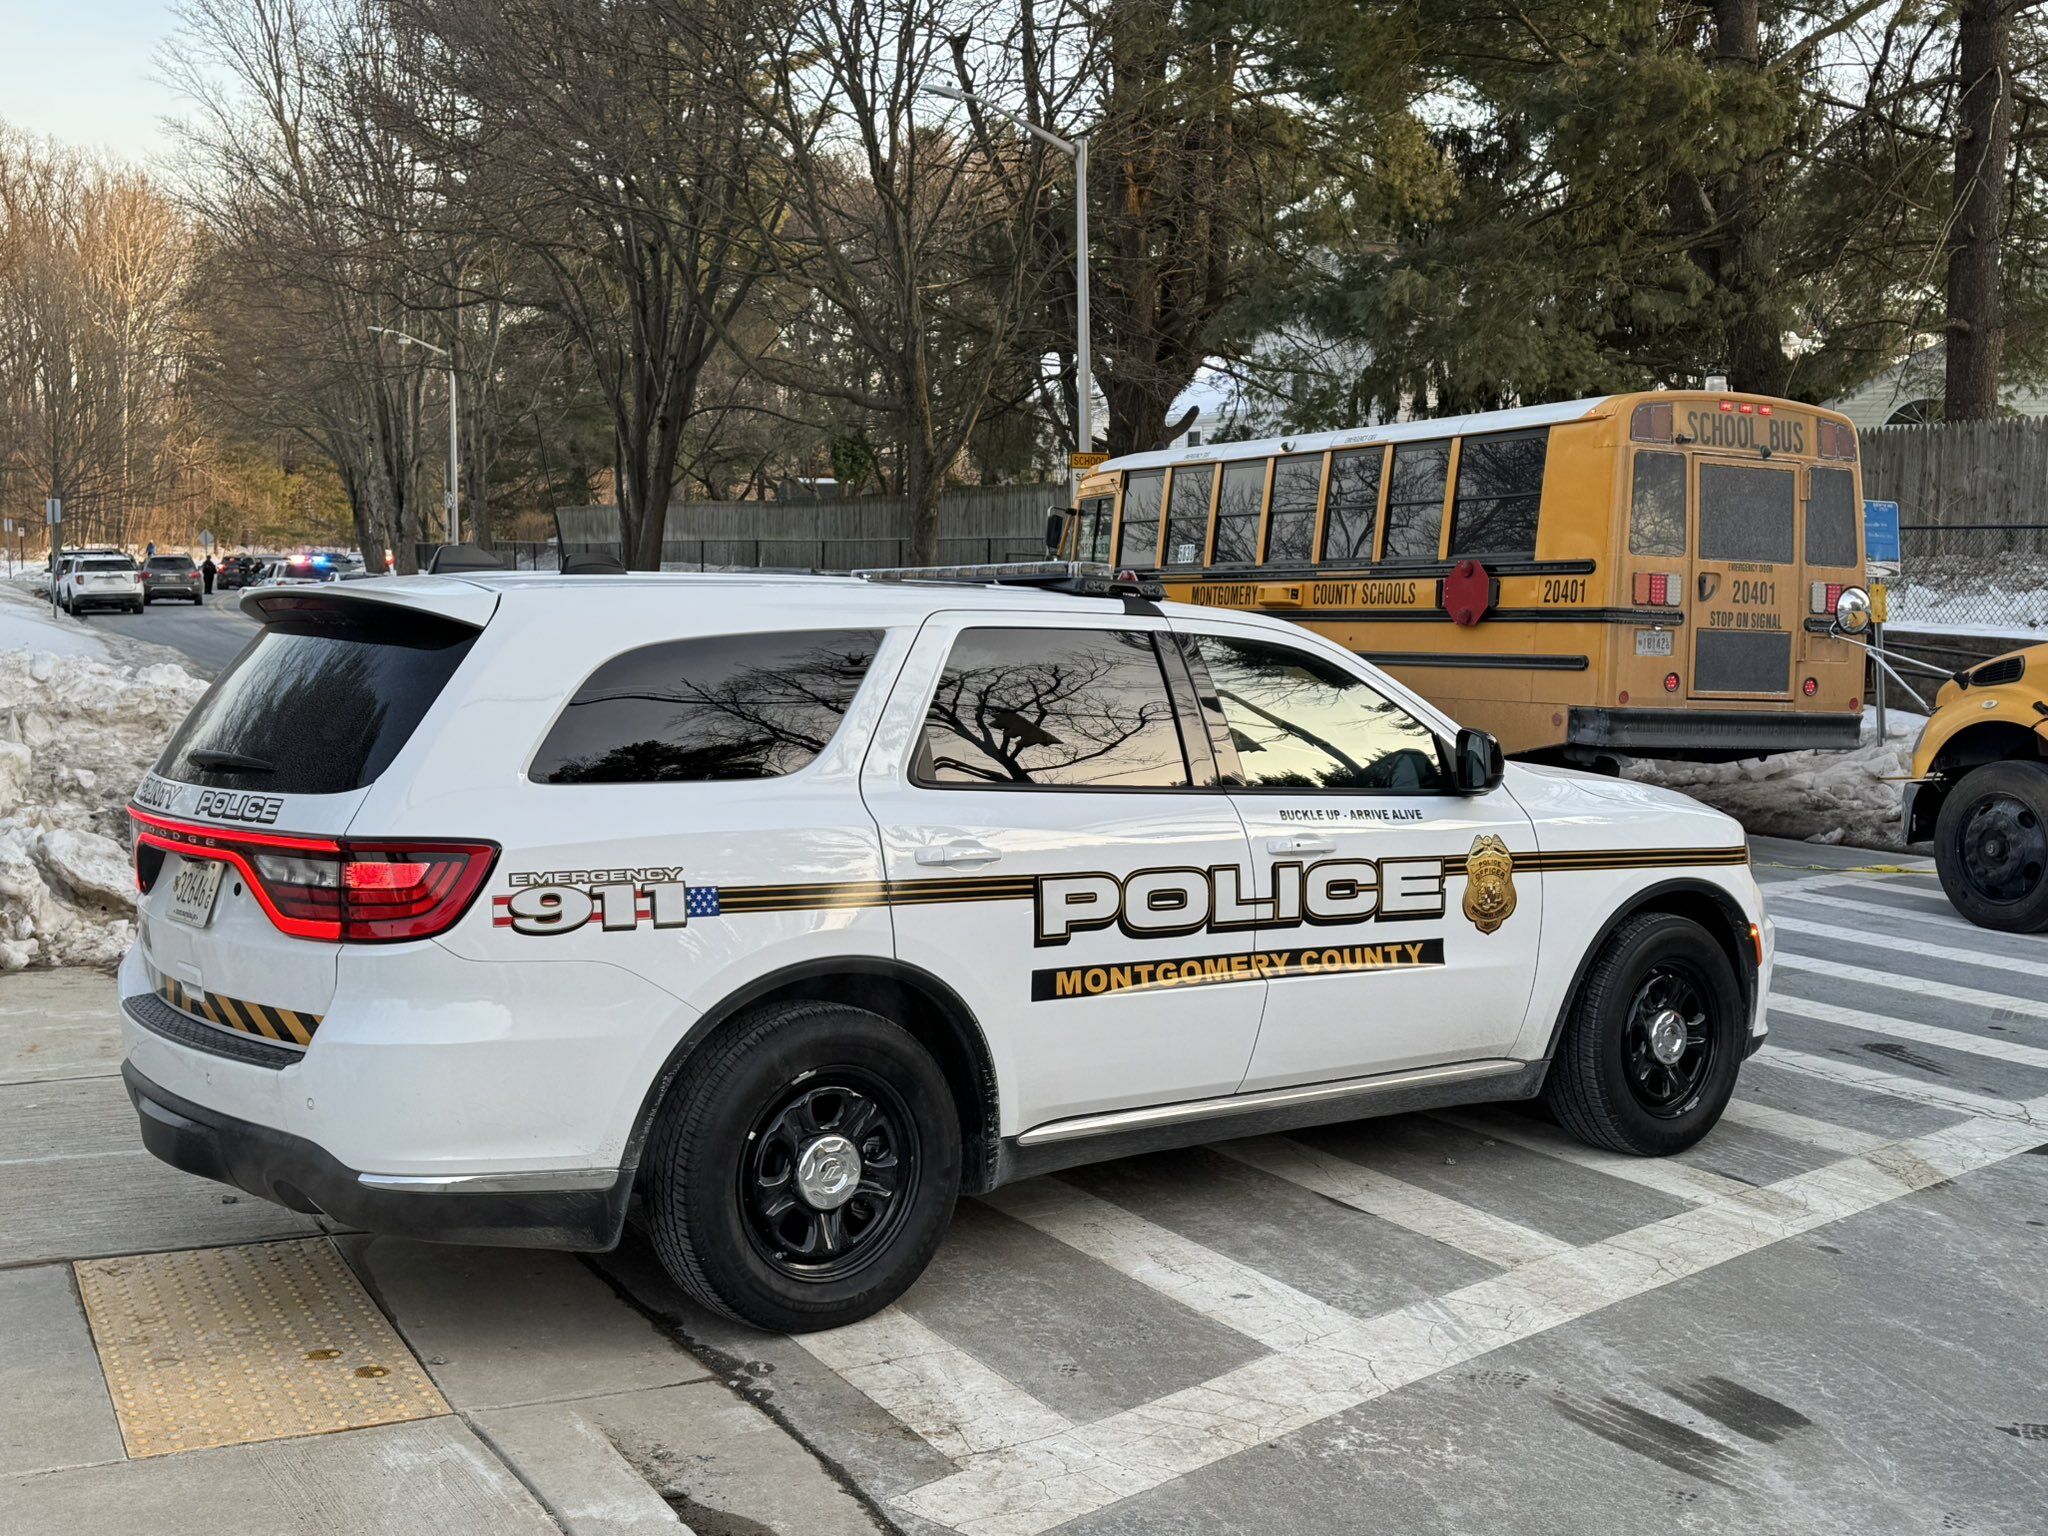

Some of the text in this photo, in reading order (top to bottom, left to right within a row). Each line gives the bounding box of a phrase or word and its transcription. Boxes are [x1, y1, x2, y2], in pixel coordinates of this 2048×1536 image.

[1688, 411, 1804, 453] SCHOOL BUS
[1728, 563, 1774, 573] EMERGENCY DOOR
[1192, 583, 1416, 606] MONTGOMERY COUNTY SCHOOLS
[1543, 579, 1586, 603] 20401
[1733, 580, 1775, 605] 20401
[1710, 611, 1782, 629] STOP ON SIGNAL
[195, 791, 284, 824] POLICE
[1280, 810, 1324, 820] BUCKLE
[1326, 810, 1340, 820] UP
[1350, 810, 1389, 820] ARRIVE
[1392, 809, 1423, 820] ALIVE
[150, 827, 216, 846] DODGE
[1475, 867, 1506, 881] OFFICER
[1479, 859, 1502, 868] POLICE
[509, 867, 683, 887] EMERGENCY
[508, 881, 687, 936] 911
[1034, 855, 1446, 949] POLICE
[1056, 942, 1423, 997] MONTGOMERY COUNTY
